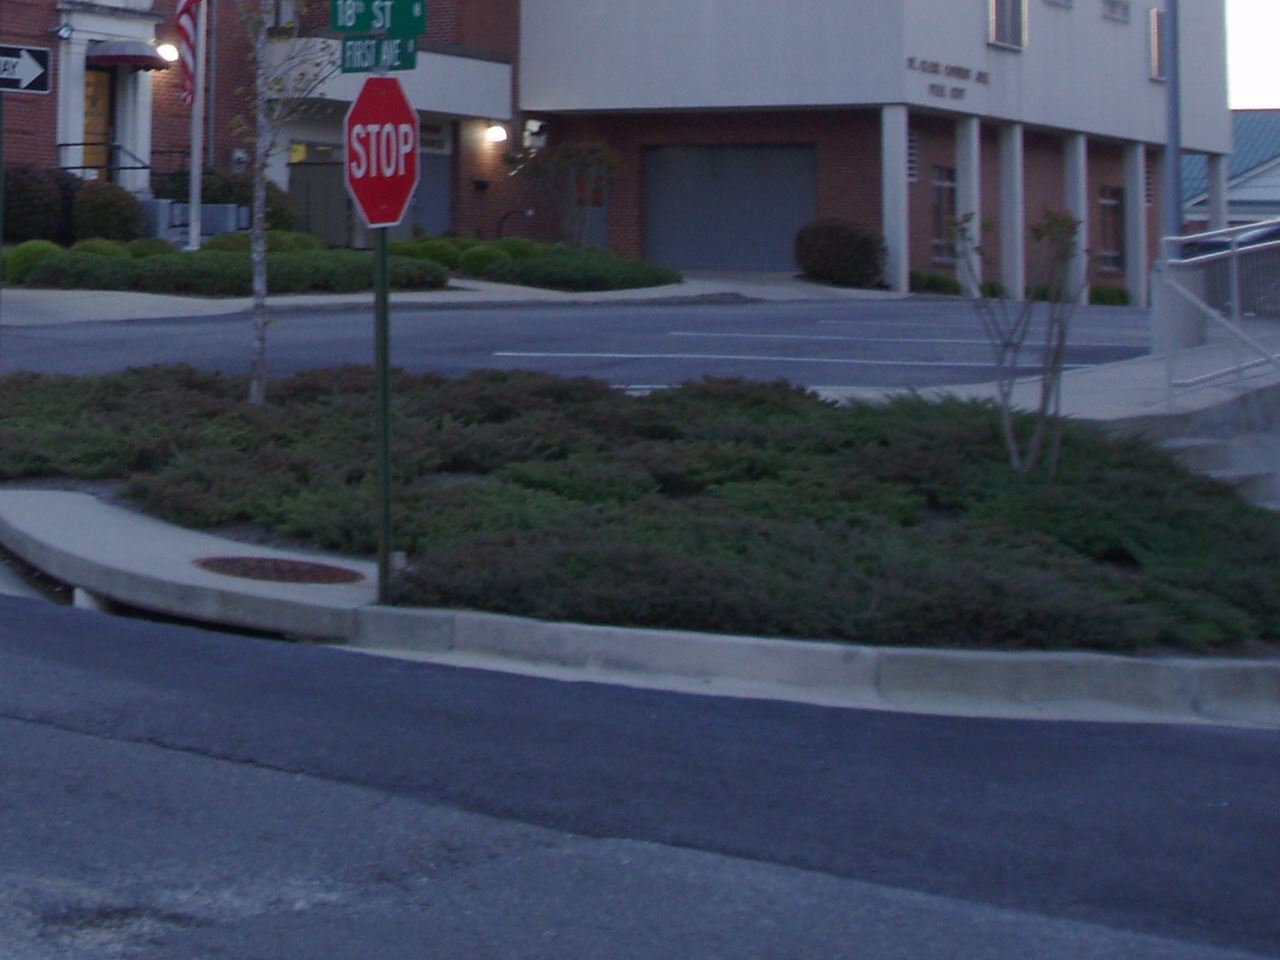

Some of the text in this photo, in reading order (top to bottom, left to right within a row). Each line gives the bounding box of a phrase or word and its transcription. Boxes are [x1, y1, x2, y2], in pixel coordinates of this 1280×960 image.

[372, 0, 394, 29] ST
[344, 39, 377, 69] FIRST
[380, 39, 401, 66] AVE
[350, 123, 414, 178] STOP
